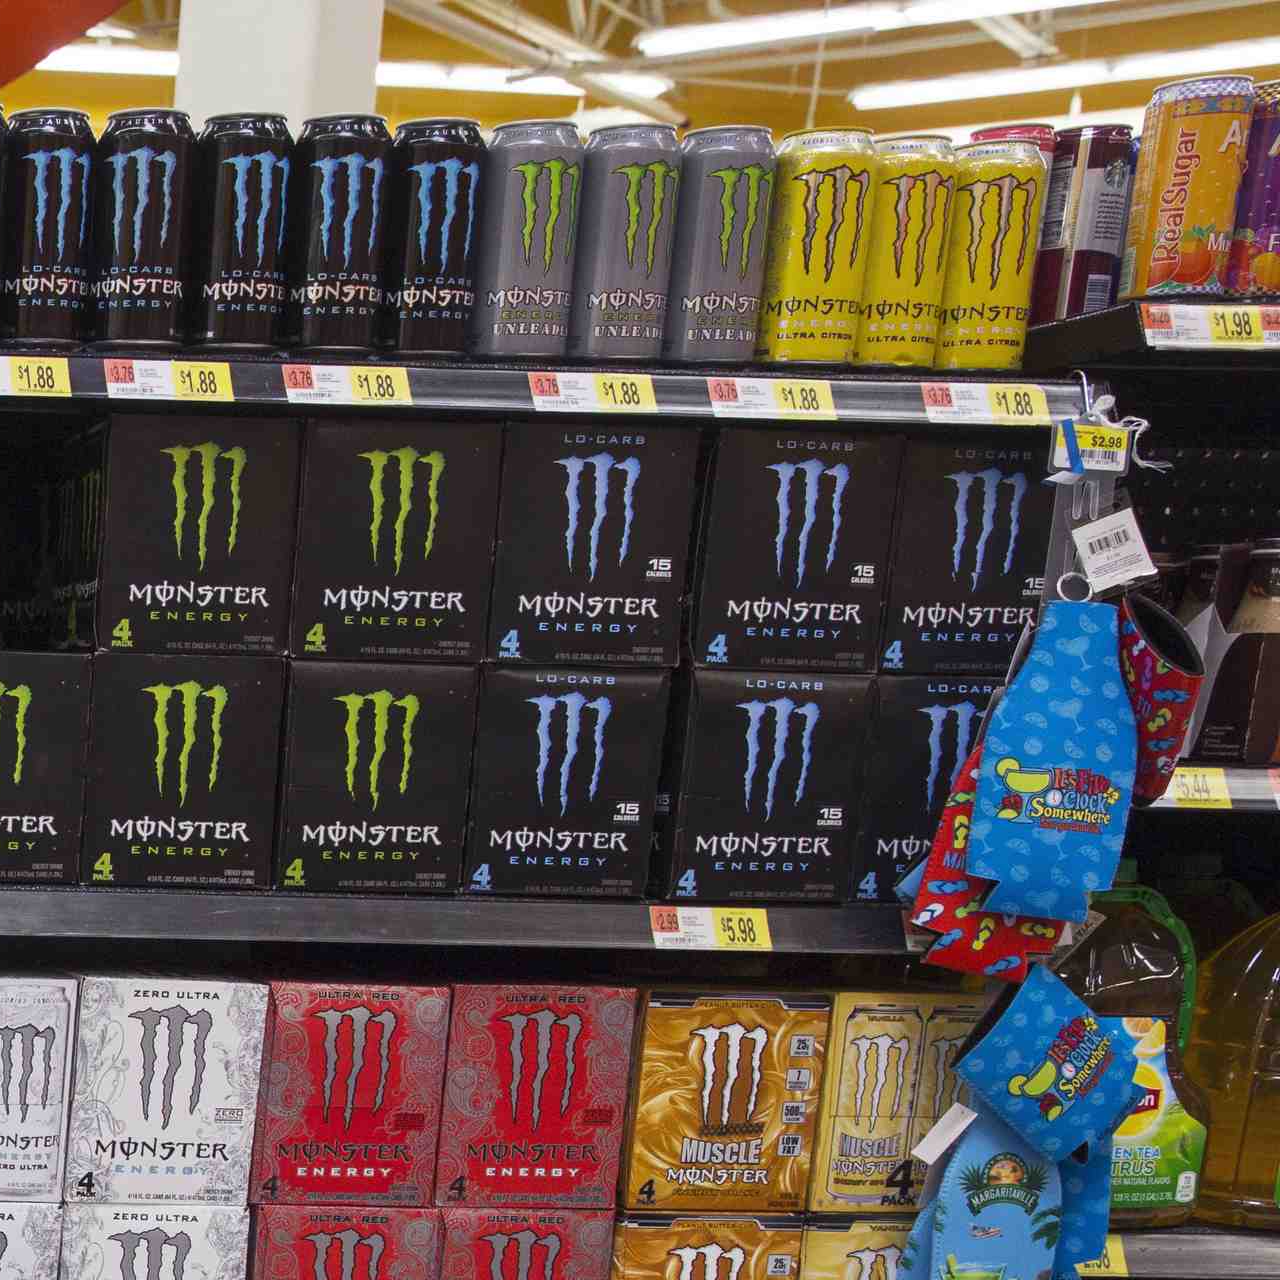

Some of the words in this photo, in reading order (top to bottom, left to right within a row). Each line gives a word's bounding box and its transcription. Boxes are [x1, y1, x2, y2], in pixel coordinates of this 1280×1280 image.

[1212, 312, 1252, 337] $1.98
[358, 372, 395, 398] $1.88
[996, 390, 1034, 415] $1.88
[1091, 433, 1123, 450] $2.98
[853, 565, 874, 579] 15
[727, 596, 862, 626] MONSTER
[746, 626, 840, 639] ENERGY
[746, 679, 824, 691] LO-CARB
[721, 914, 757, 945] $5.98
[94, 1138, 230, 1162] MONSTER
[680, 1137, 761, 1164] MUSCLE
[782, 1136, 800, 1146] LOW
[783, 1146, 796, 1155] FAT
[296, 1167, 392, 1177] ENERGY
[667, 1166, 768, 1185] MONSTER
